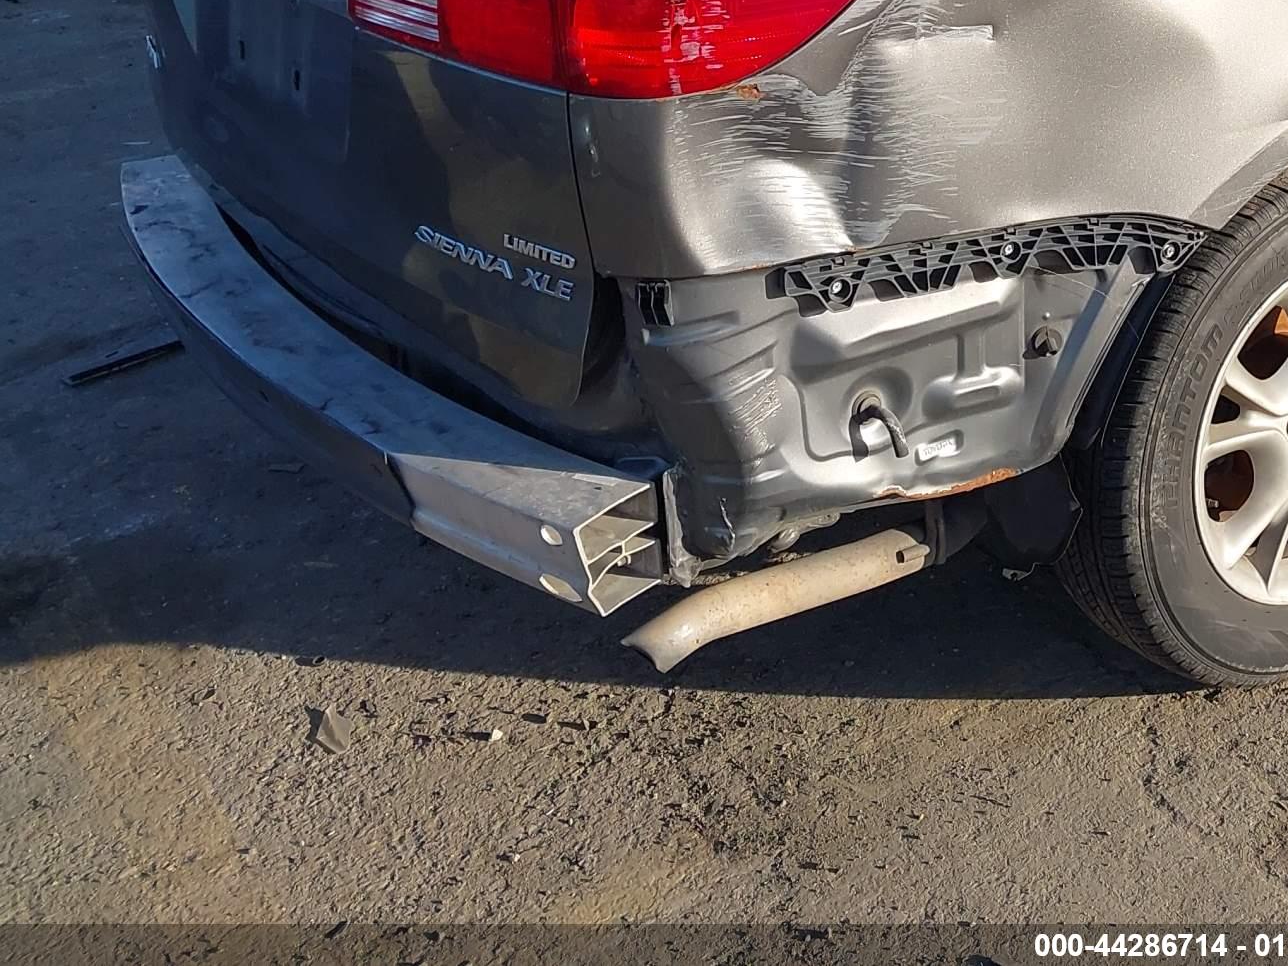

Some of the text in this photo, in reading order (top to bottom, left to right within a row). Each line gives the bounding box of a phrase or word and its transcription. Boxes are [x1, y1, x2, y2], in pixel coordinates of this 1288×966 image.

[414, 225, 575, 301] SIENNA XLE
[503, 234, 576, 269] LIMITED
